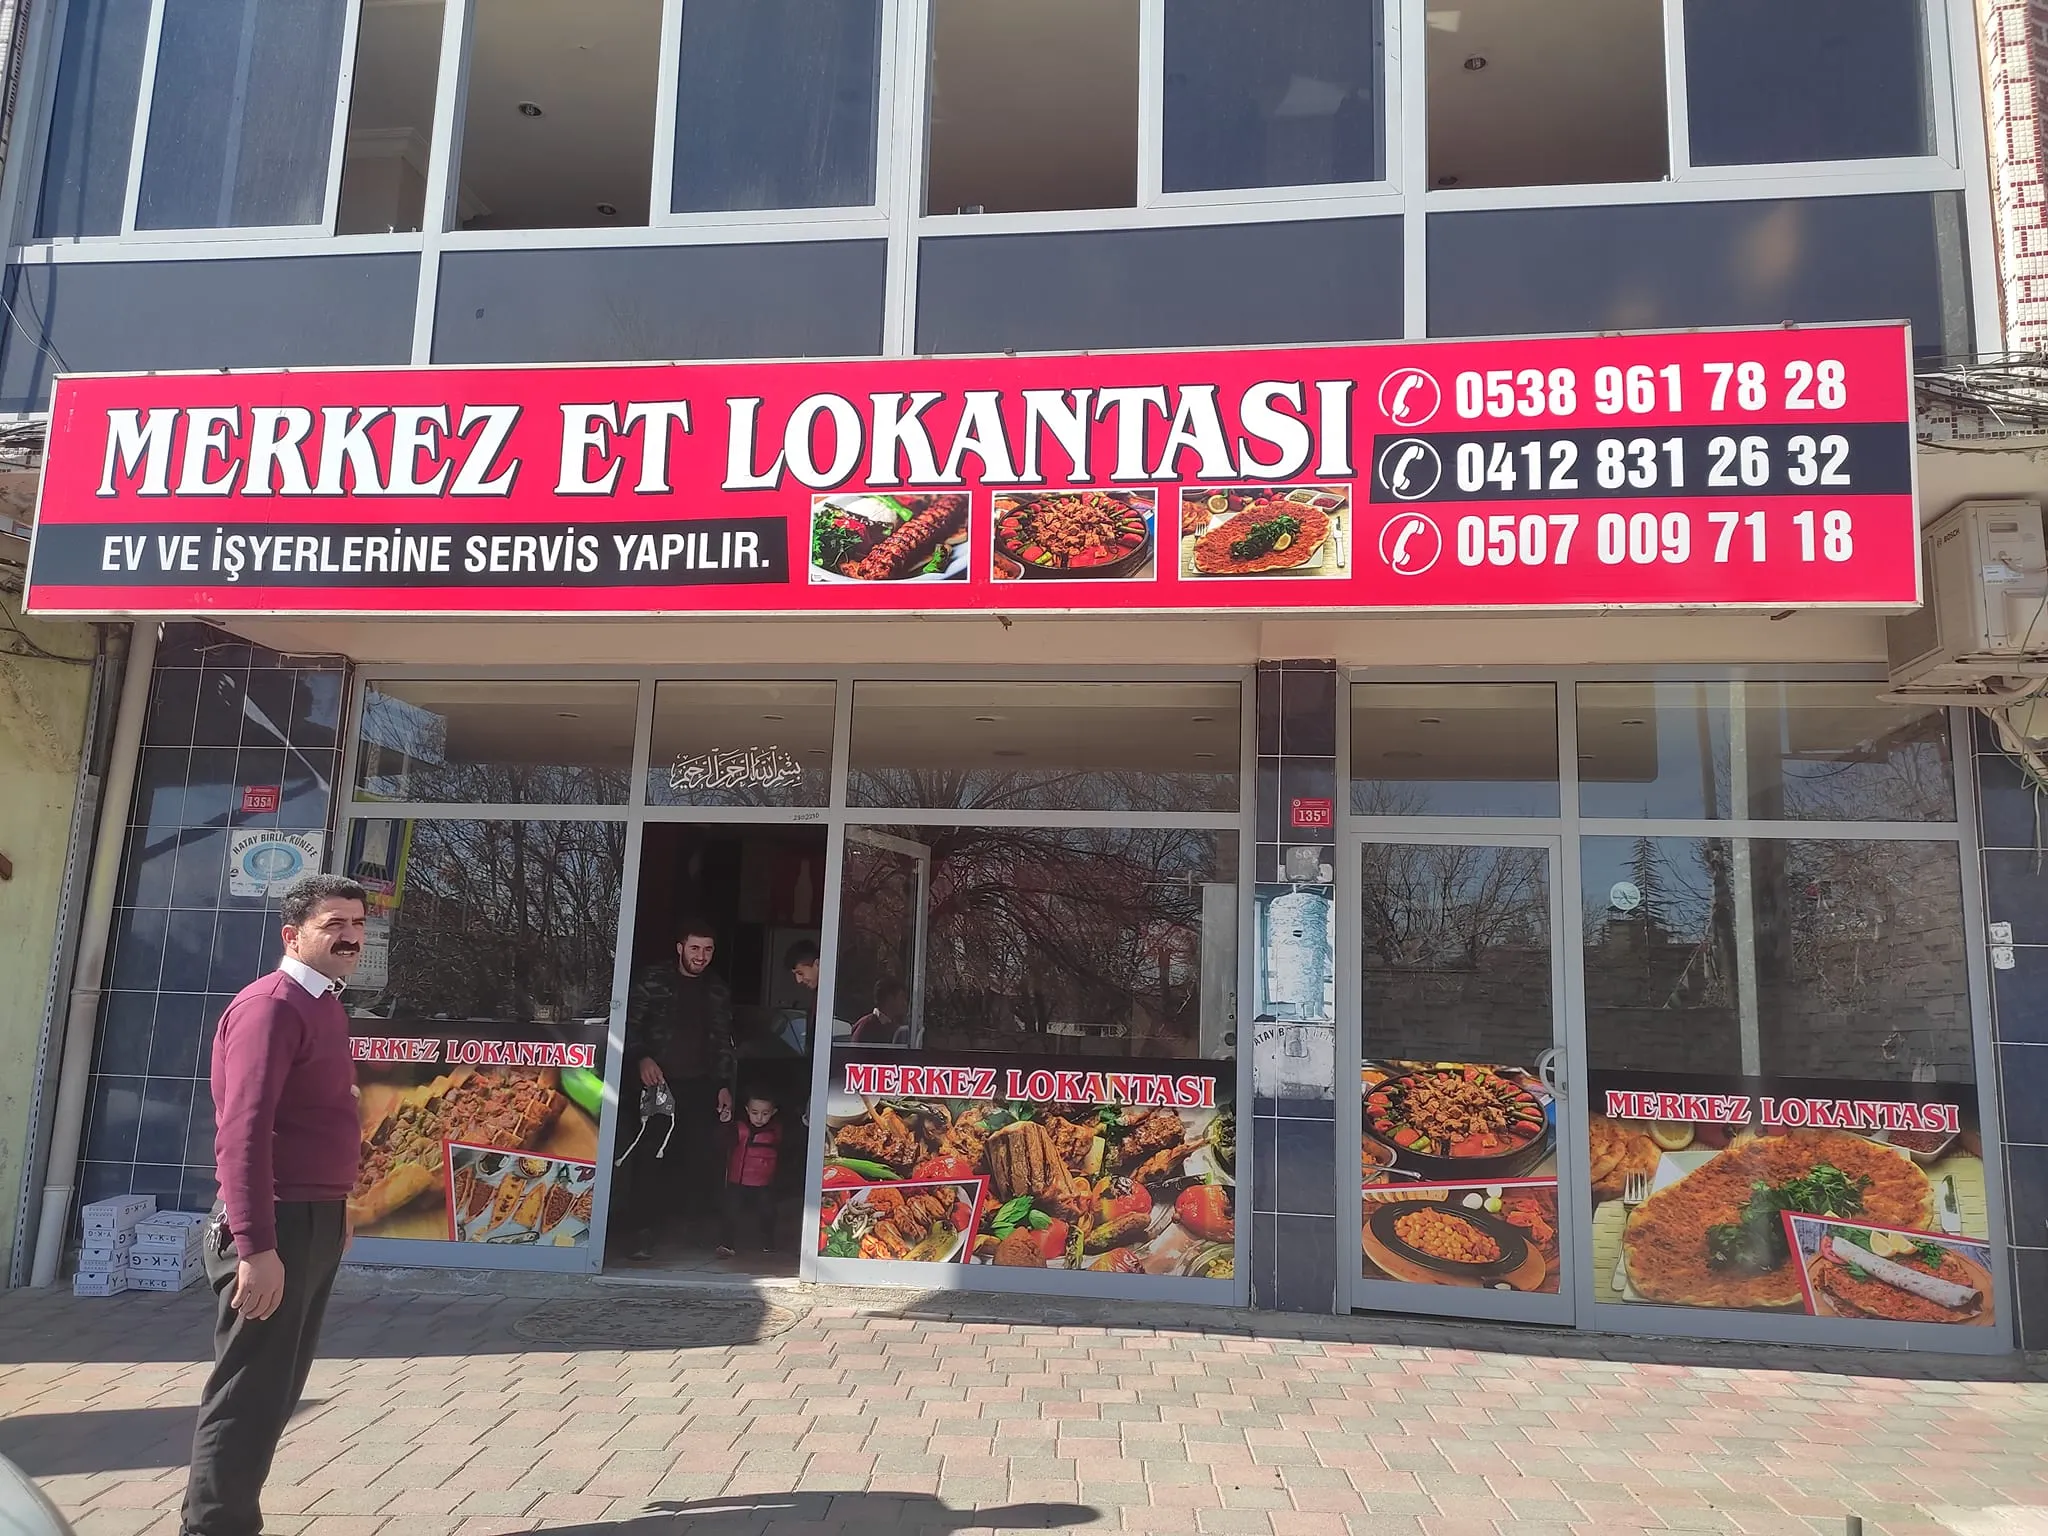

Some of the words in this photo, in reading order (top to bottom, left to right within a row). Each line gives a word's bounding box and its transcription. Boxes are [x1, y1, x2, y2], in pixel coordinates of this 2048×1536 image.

[1455, 367, 1577, 419] 0538
[1594, 364, 1683, 415] 961
[1703, 361, 1767, 411] 78
[1784, 359, 1847, 410] 28
[96, 405, 523, 498] MERKEZ
[554, 400, 693, 496] ET
[721, 379, 1356, 491] LOKANTASI
[1456, 440, 1579, 492] 0412
[1597, 437, 1685, 489] 831
[1708, 435, 1770, 487] 26
[1787, 434, 1851, 486] 32
[101, 536, 147, 571] EV
[157, 536, 202, 571] VE
[211, 527, 452, 582] İŞYERLERİNE
[464, 526, 599, 574] SERVİS
[612, 532, 770, 571] YAPILIR.
[1457, 514, 1579, 567] 0507
[1598, 512, 1691, 565] 009
[1708, 511, 1767, 563] 71
[1793, 510, 1854, 562] 18
[232, 834, 259, 855] HATAY
[348, 1037, 440, 1063] ERKEZ
[445, 1039, 597, 1069] LOKANTASI
[844, 1063, 998, 1101] MERKEZ
[1005, 1068, 1217, 1109] LOKANTASI
[1605, 1090, 1752, 1125] MERKEZ
[1759, 1096, 1961, 1134] LOKANTASI
